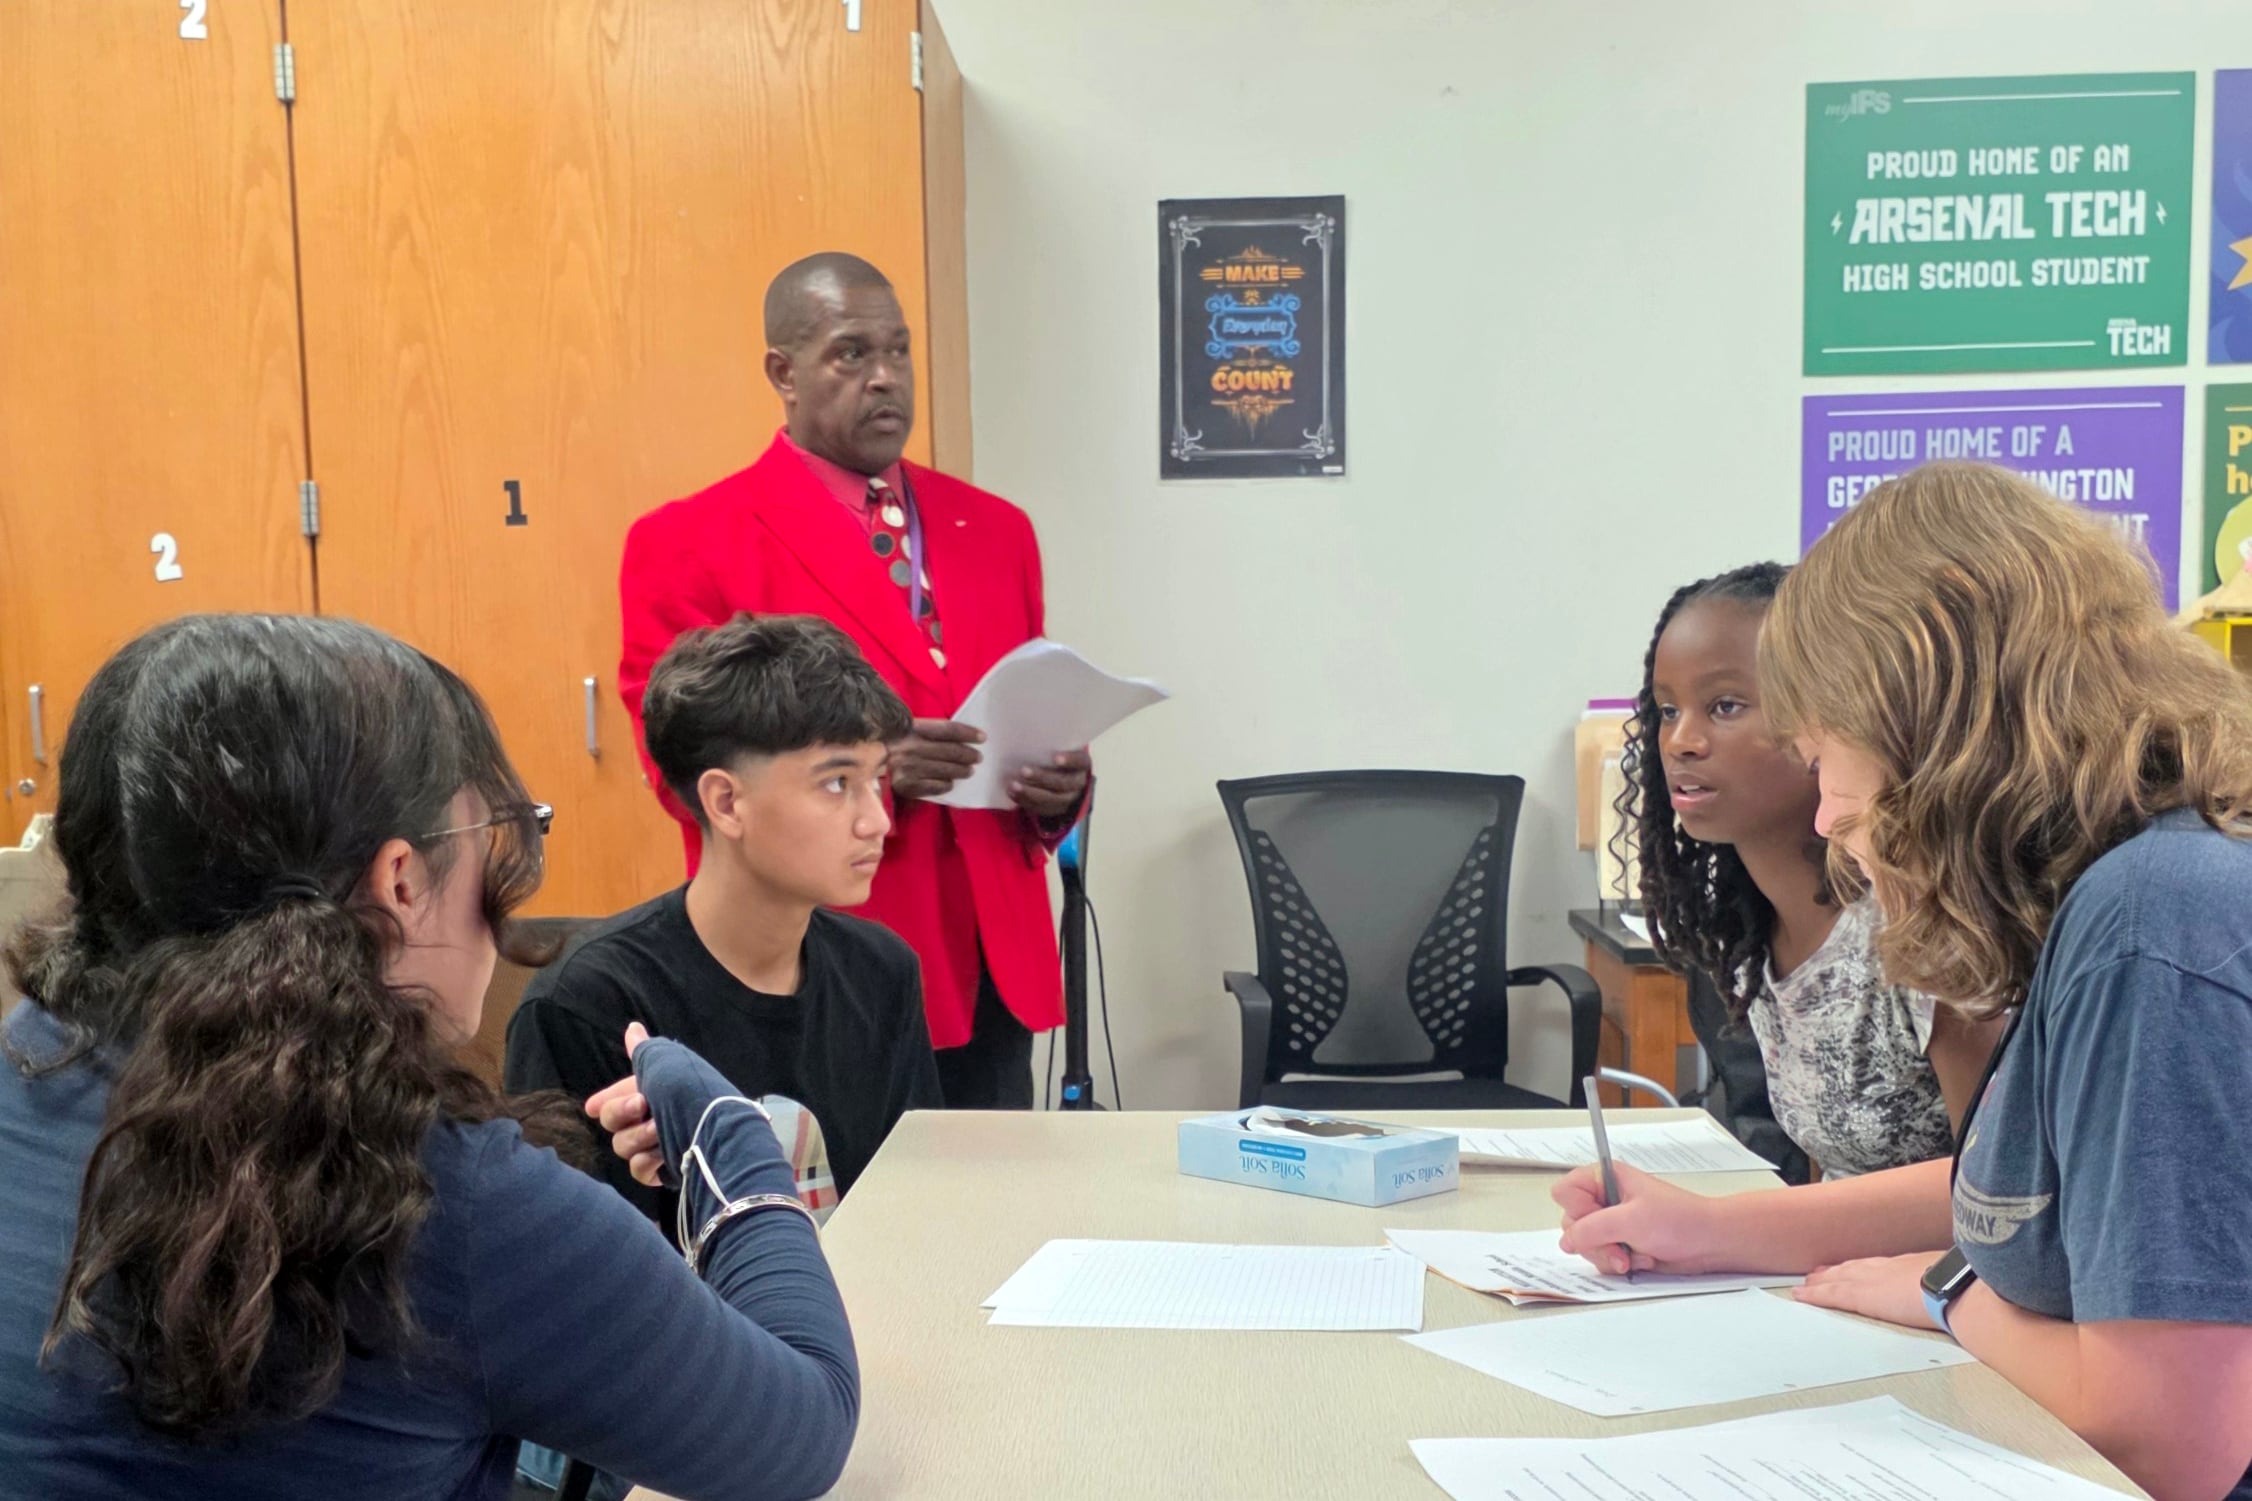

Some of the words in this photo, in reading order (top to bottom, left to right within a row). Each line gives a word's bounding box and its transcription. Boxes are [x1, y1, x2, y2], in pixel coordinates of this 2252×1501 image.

[179, 0, 208, 40] 2
[841, 0, 862, 32] 1
[1867, 149, 1958, 180] PROUD
[1968, 146, 2040, 177] HOME
[2050, 145, 2085, 175] OF
[2093, 143, 2131, 172] AN
[1849, 193, 2036, 245] ARSENAL
[2045, 189, 2147, 239] TECH
[1225, 265, 1280, 282] MAKE
[1843, 263, 1910, 293] HIGH
[1919, 259, 2023, 290] SCHOOL
[2031, 255, 2151, 288] STUDENT
[2106, 325, 2171, 356] TECH
[1211, 369, 1294, 391] COUNT
[1827, 428, 1917, 463] PROUD
[1925, 426, 2004, 460] HOME
[2011, 425, 2047, 458] OF
[2054, 424, 2075, 456] A
[502, 480, 529, 526] 1
[150, 532, 183, 582] 2
